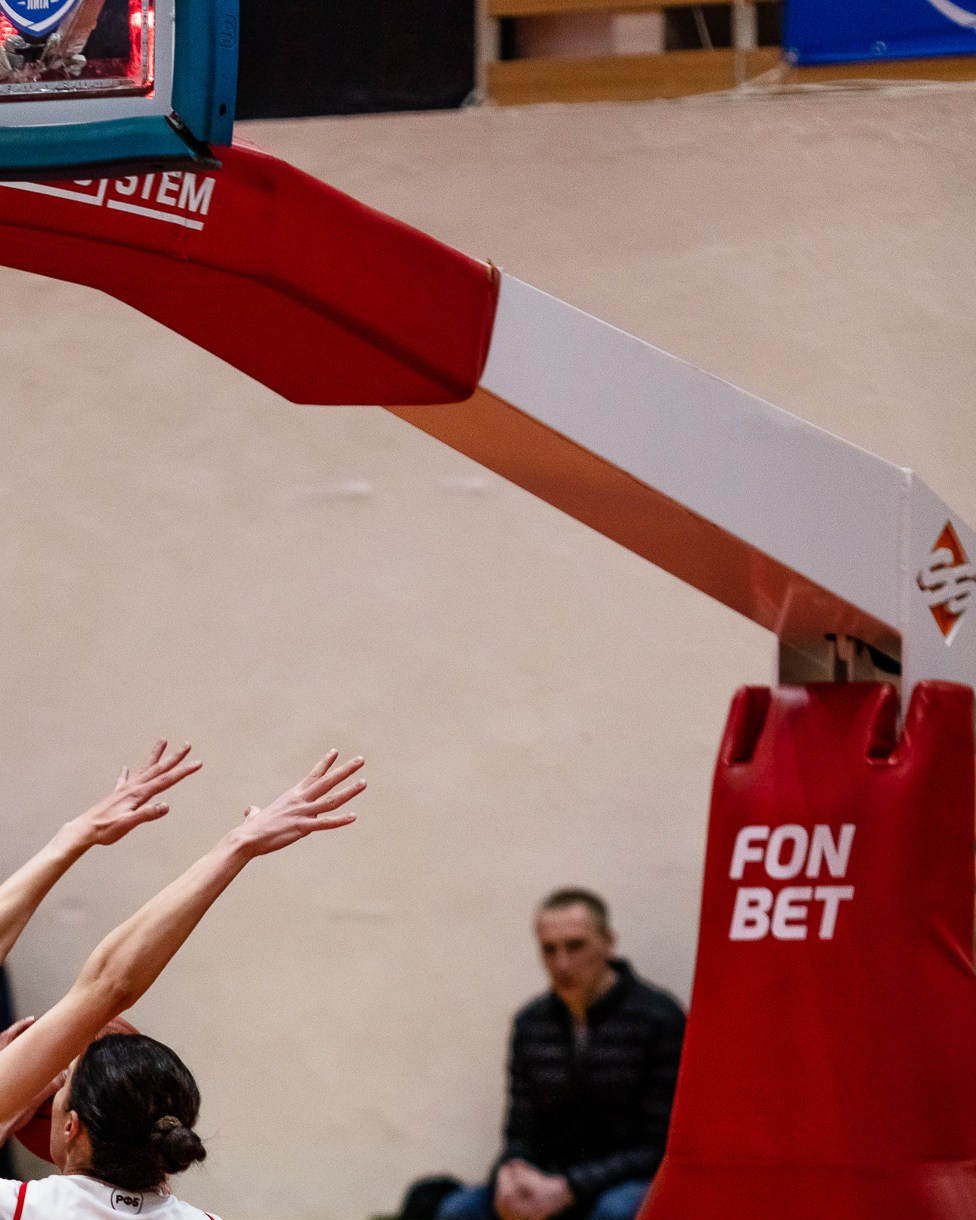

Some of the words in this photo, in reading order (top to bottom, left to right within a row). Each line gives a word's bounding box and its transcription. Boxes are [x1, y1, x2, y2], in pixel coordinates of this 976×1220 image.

[728, 822, 857, 880] FON
[728, 884, 855, 941] BET
[115, 1194, 140, 1207] РФБ
